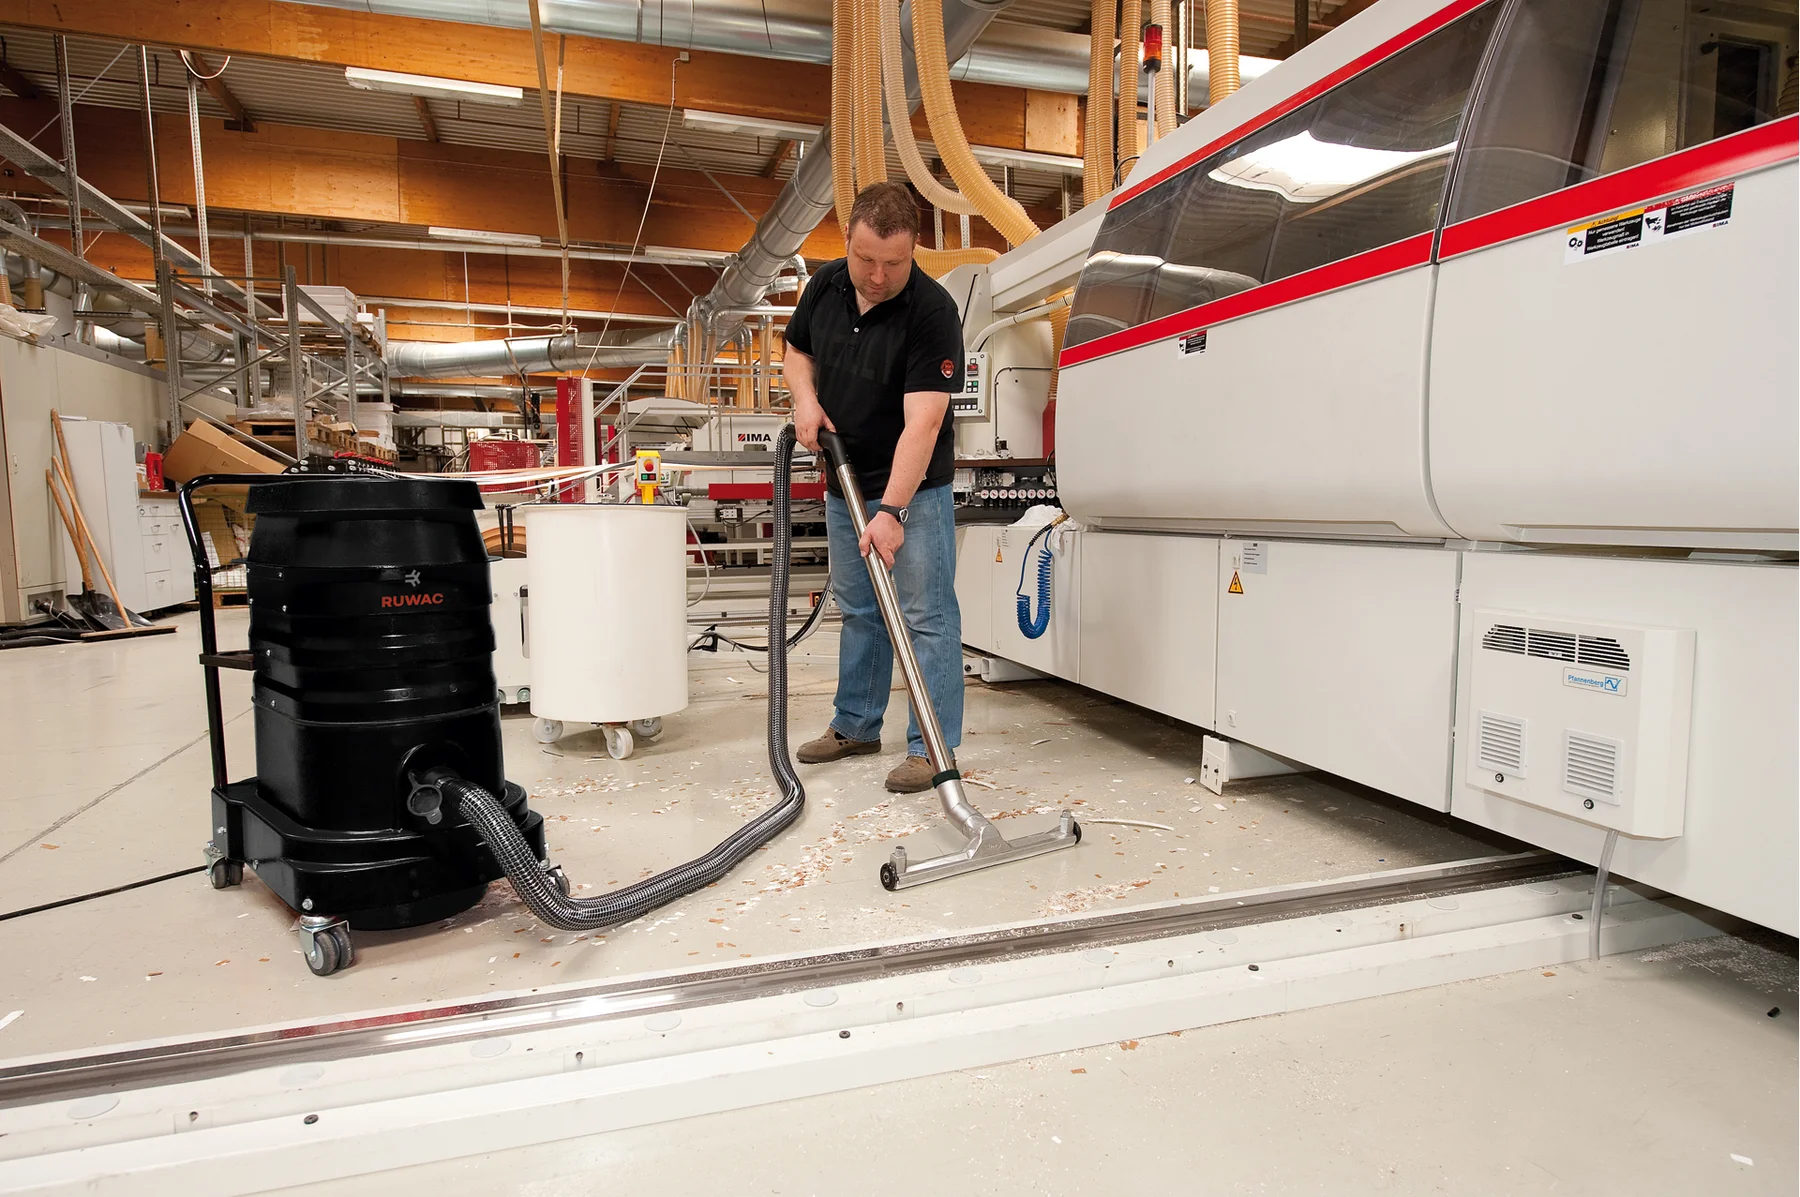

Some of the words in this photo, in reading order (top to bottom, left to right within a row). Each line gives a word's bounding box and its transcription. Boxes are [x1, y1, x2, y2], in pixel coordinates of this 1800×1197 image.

[746, 433, 772, 442] IMA
[381, 592, 444, 608] RUWAC
[1567, 674, 1604, 688] Pfannenberg
